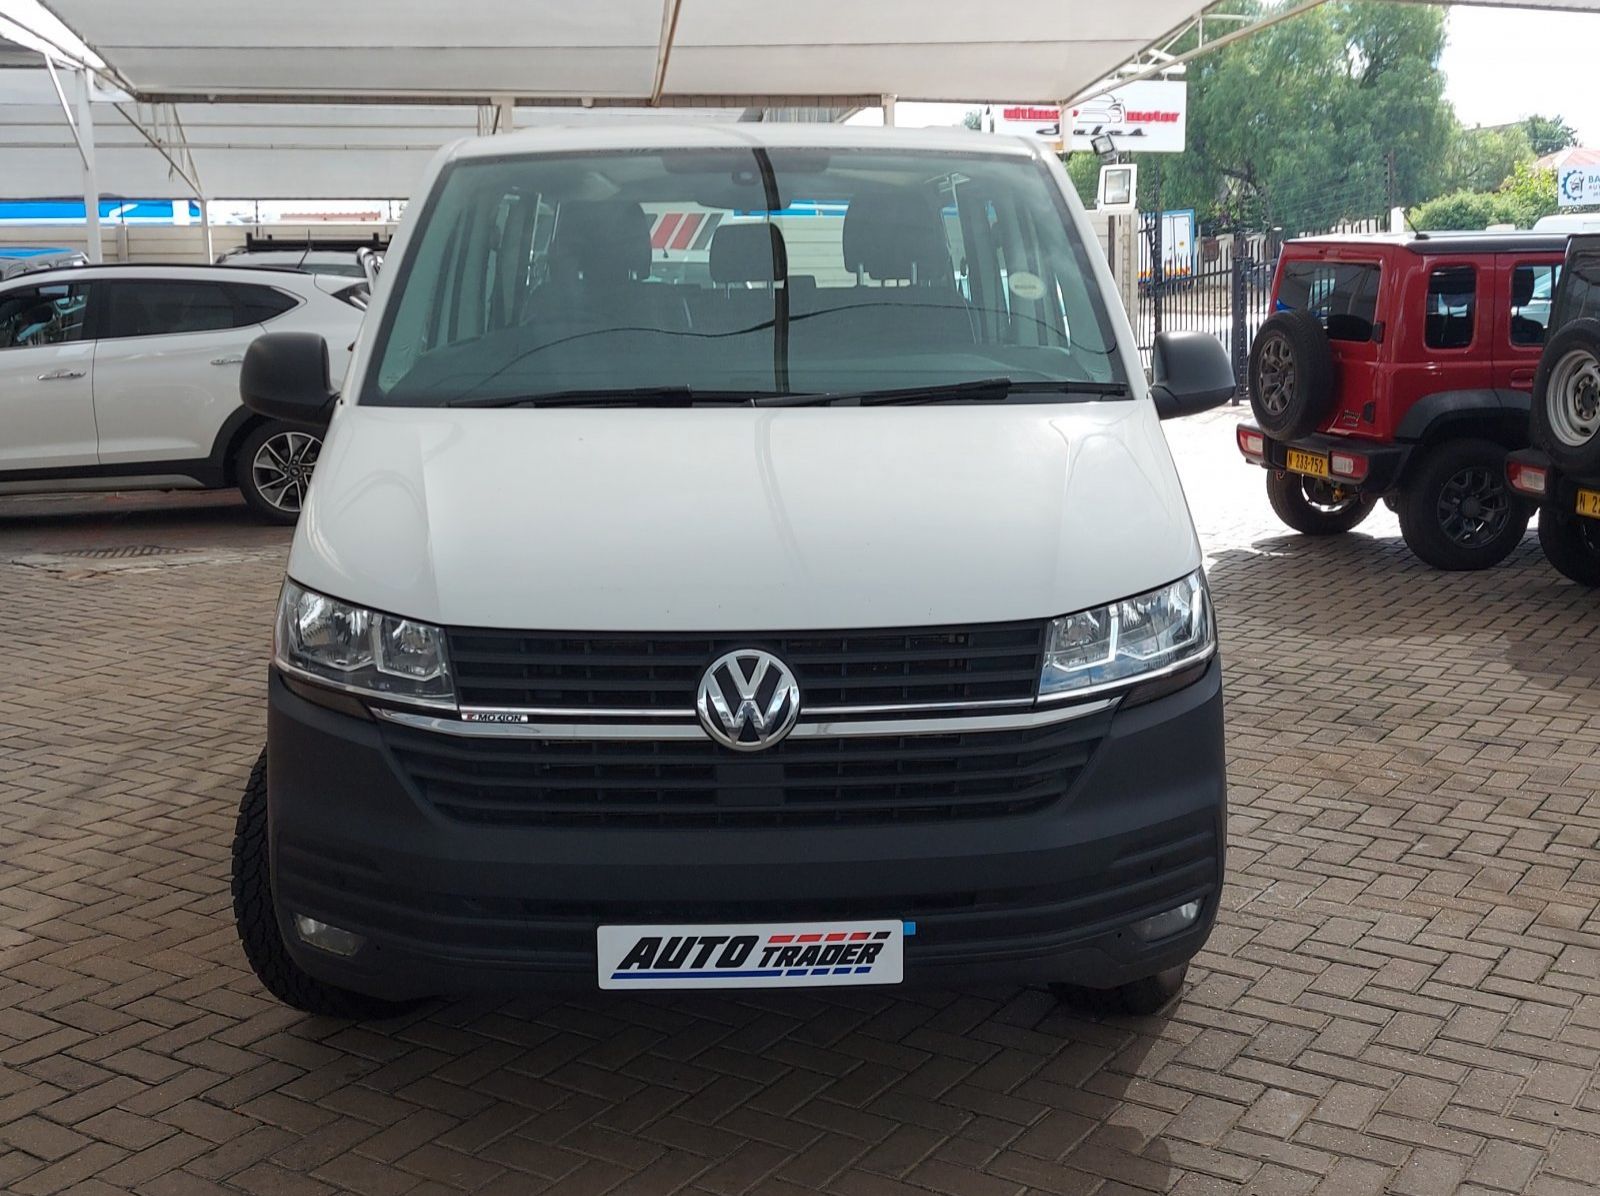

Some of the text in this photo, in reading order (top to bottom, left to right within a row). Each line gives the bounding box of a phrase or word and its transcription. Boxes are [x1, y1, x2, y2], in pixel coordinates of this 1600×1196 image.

[1126, 109, 1180, 122] motor
[1296, 454, 1324, 474] 233-752
[1580, 492, 1600, 514] N 2
[616, 935, 884, 970] AUTO TRADER
